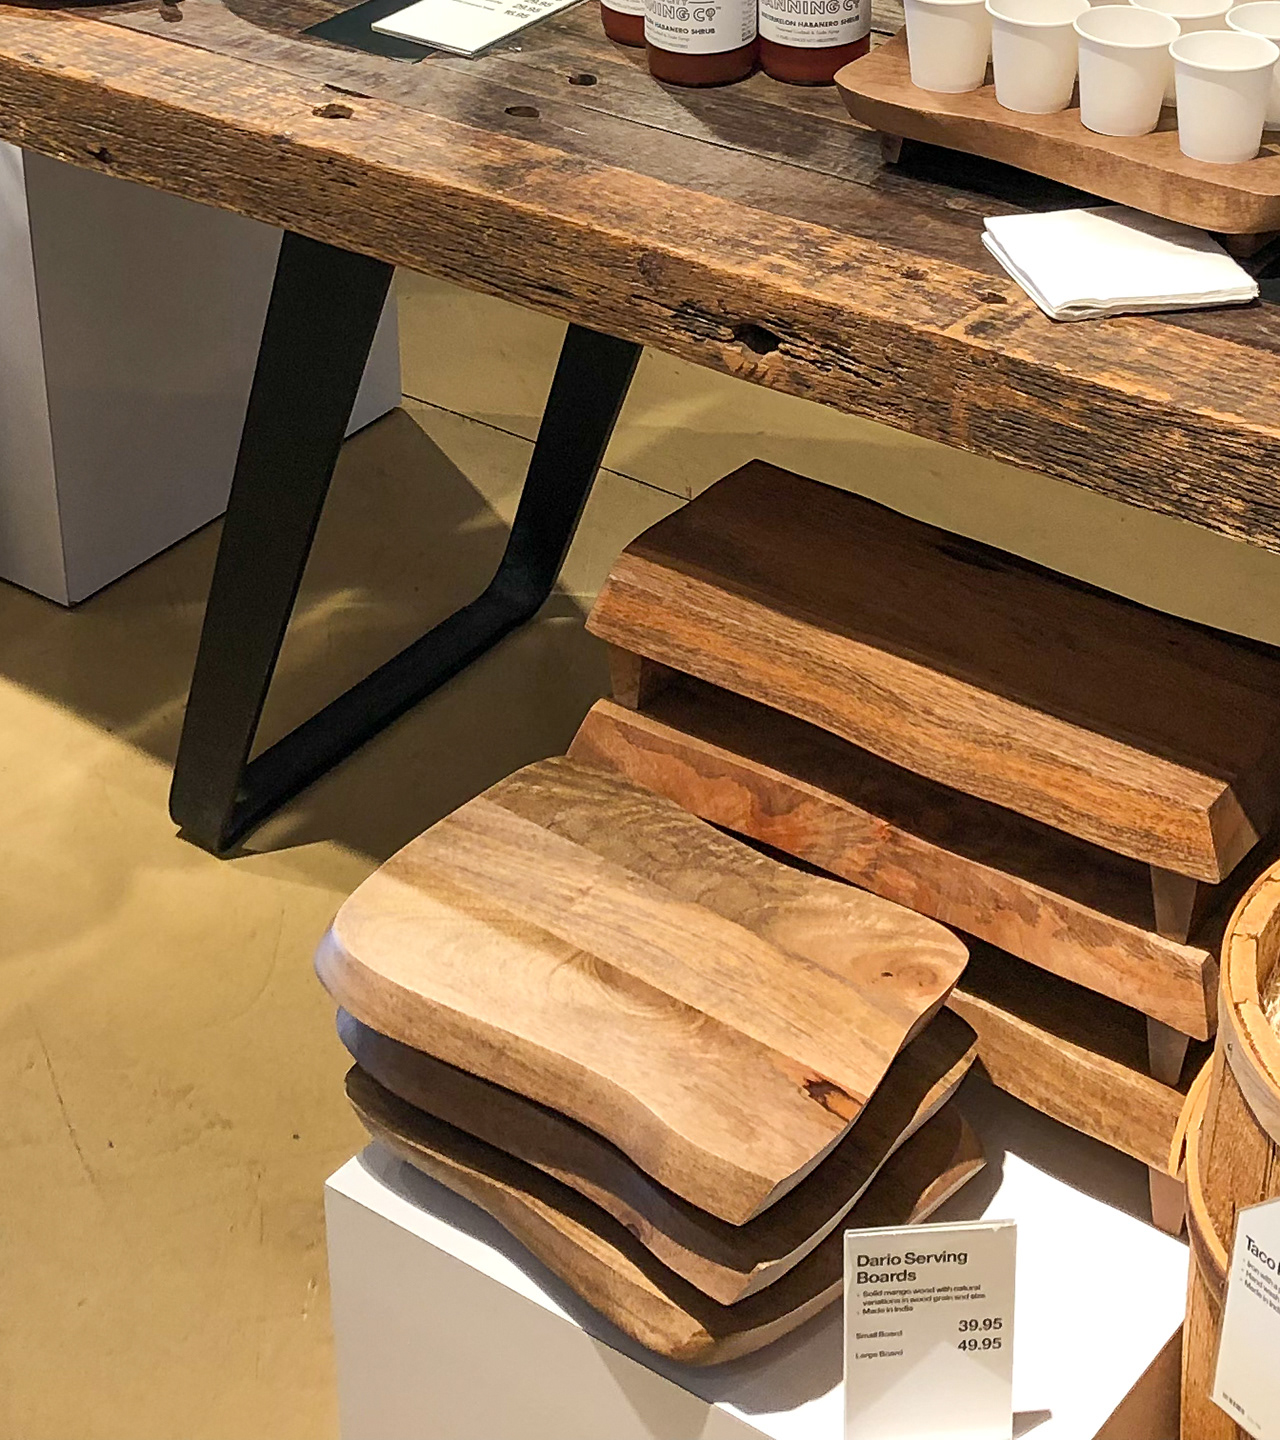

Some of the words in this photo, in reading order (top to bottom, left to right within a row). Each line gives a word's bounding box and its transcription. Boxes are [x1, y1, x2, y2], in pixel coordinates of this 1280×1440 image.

[798, 20, 839, 28] HABANERO
[857, 1253, 902, 1267] Dario
[904, 1250, 968, 1265] Serving
[1245, 1234, 1276, 1270] Taco
[856, 1269, 917, 1284] Boards
[883, 1289, 912, 1297] mango
[953, 1284, 981, 1292] natural
[862, 1307, 885, 1315] Made
[958, 1317, 1003, 1332] 39.95
[856, 1332, 878, 1340] Small
[878, 1330, 903, 1338] Board
[957, 1337, 1002, 1352] 49.95
[879, 1349, 904, 1358] Board
